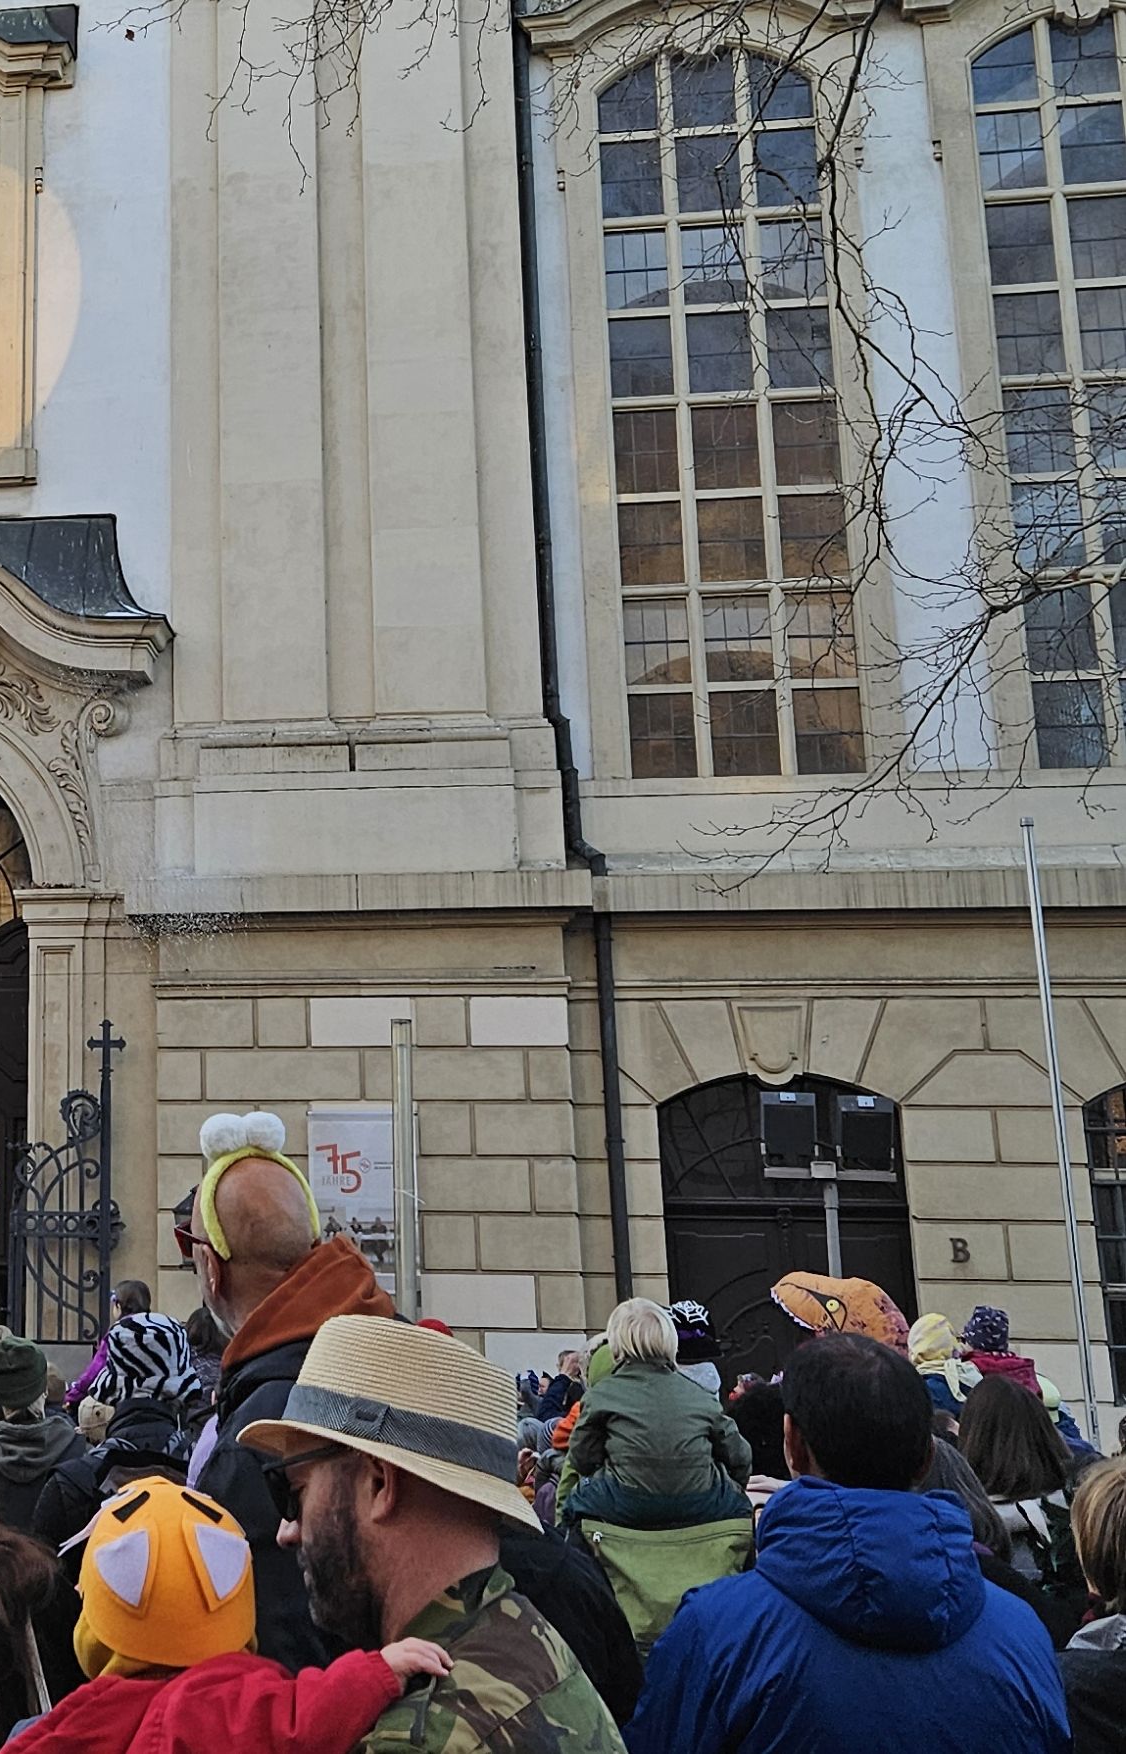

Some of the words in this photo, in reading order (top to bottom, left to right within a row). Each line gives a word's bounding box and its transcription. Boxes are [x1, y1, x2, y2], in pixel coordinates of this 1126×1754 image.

[315, 1144, 362, 1194] 75
[321, 1176, 351, 1186] JAHRE
[949, 1237, 970, 1263] B
